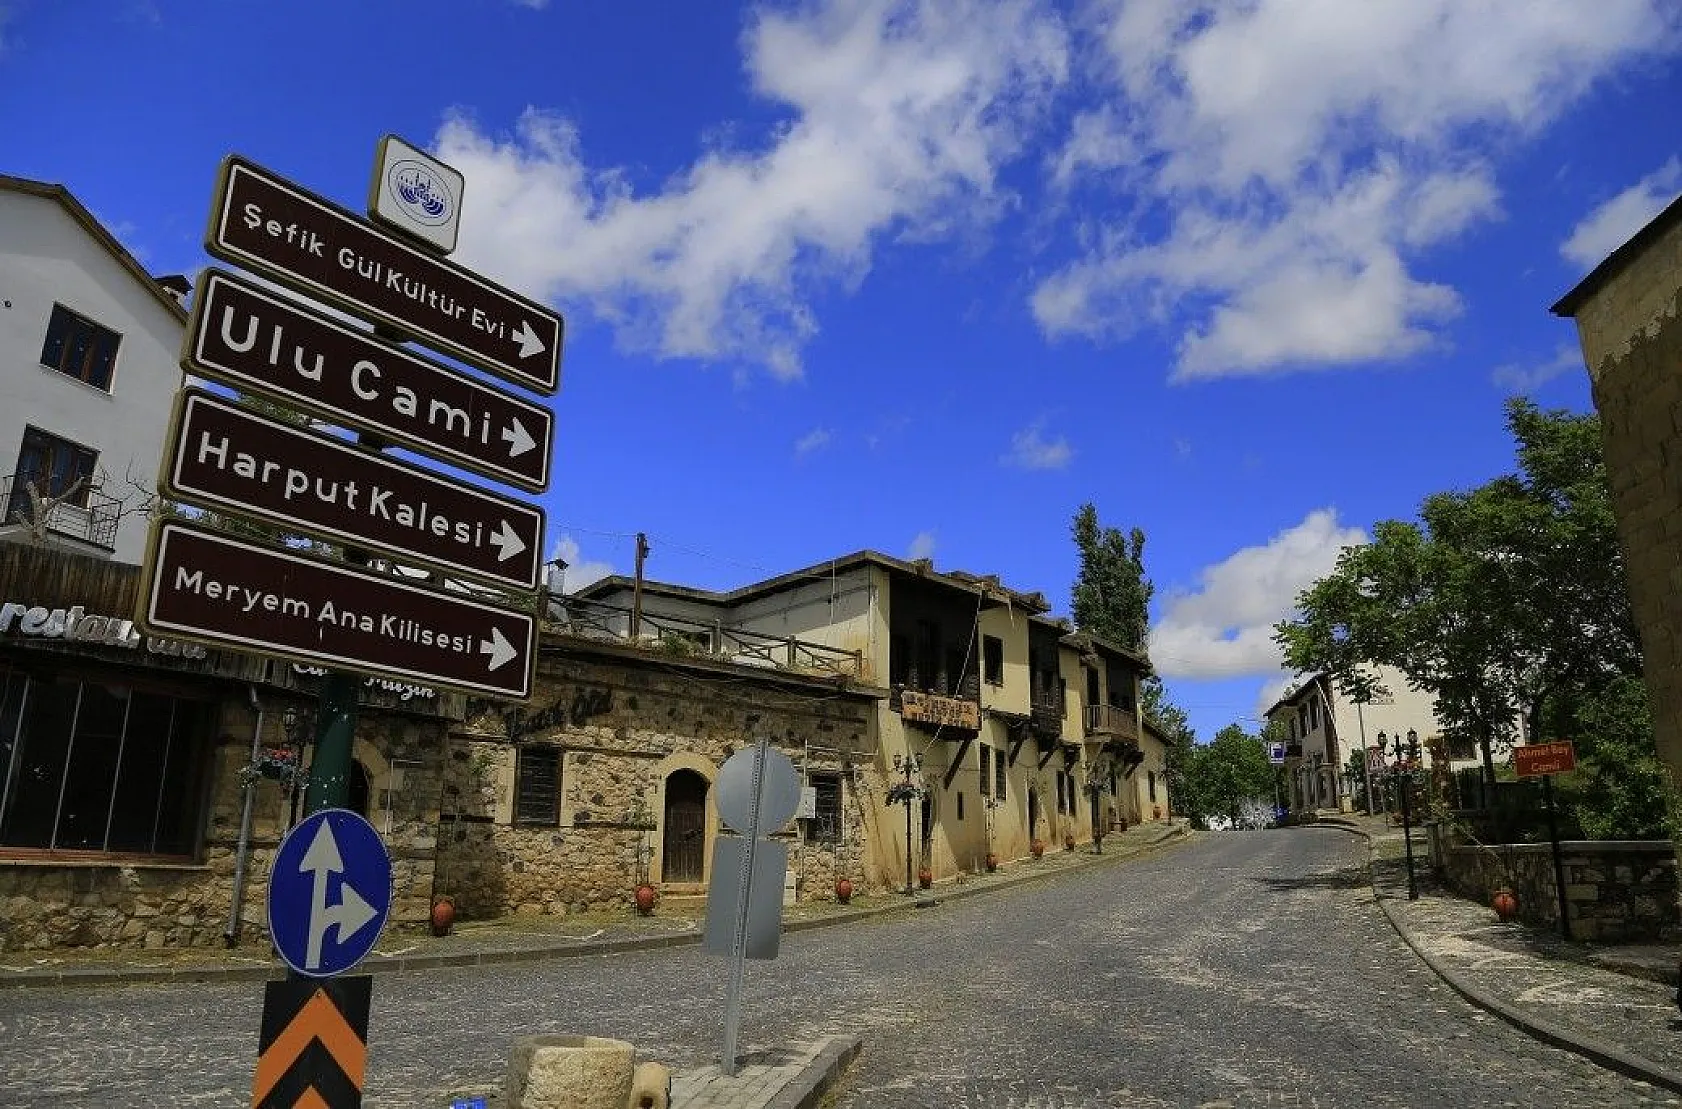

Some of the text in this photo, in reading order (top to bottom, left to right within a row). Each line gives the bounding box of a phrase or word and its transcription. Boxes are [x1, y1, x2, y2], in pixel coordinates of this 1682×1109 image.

[242, 203, 506, 339] Şefik Gül Kültür Evi
[221, 305, 491, 444] Ulu Cami
[198, 431, 483, 547] Harput Kalesi
[174, 566, 472, 654] Meryem Ana Kilisesi
